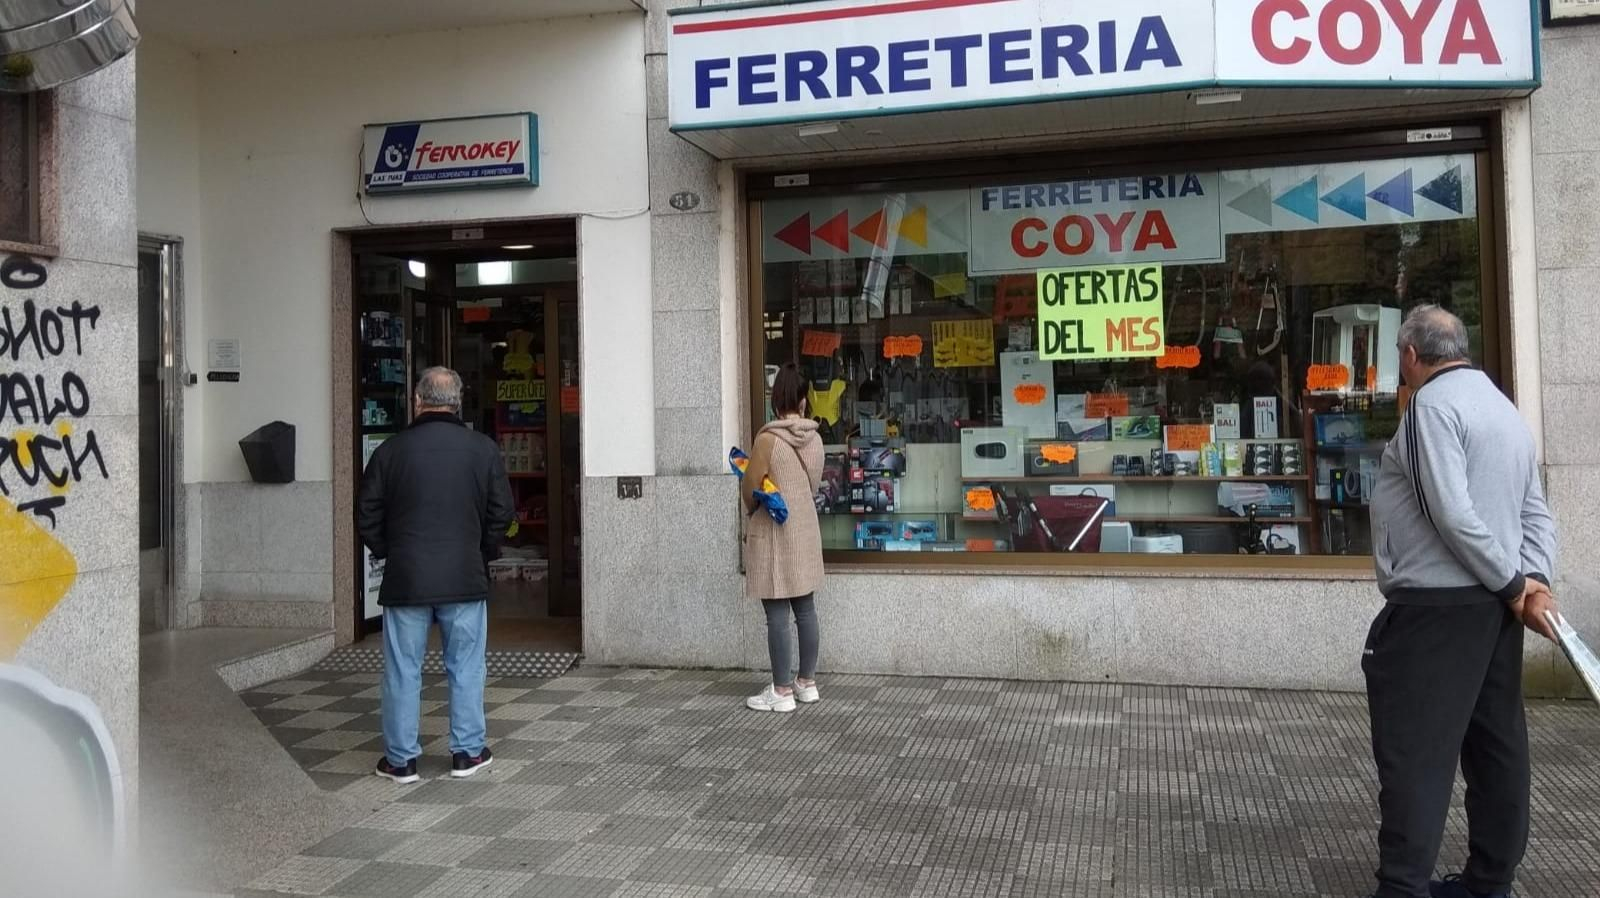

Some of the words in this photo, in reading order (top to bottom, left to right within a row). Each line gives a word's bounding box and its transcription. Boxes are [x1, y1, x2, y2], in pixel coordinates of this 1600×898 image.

[1251, 0, 1503, 66] COYA
[694, 15, 1183, 109] FERRETERIA
[675, 194, 693, 207] 51
[982, 173, 1204, 211] FERRETERIA
[1010, 209, 1177, 258] COYA
[1042, 267, 1159, 307] OFERTAS
[1044, 319, 1095, 354] DEL
[1105, 316, 1161, 352] MES
[498, 382, 527, 399] SUPER
[1256, 400, 1273, 408] BALI
[1217, 418, 1237, 427] BALI
